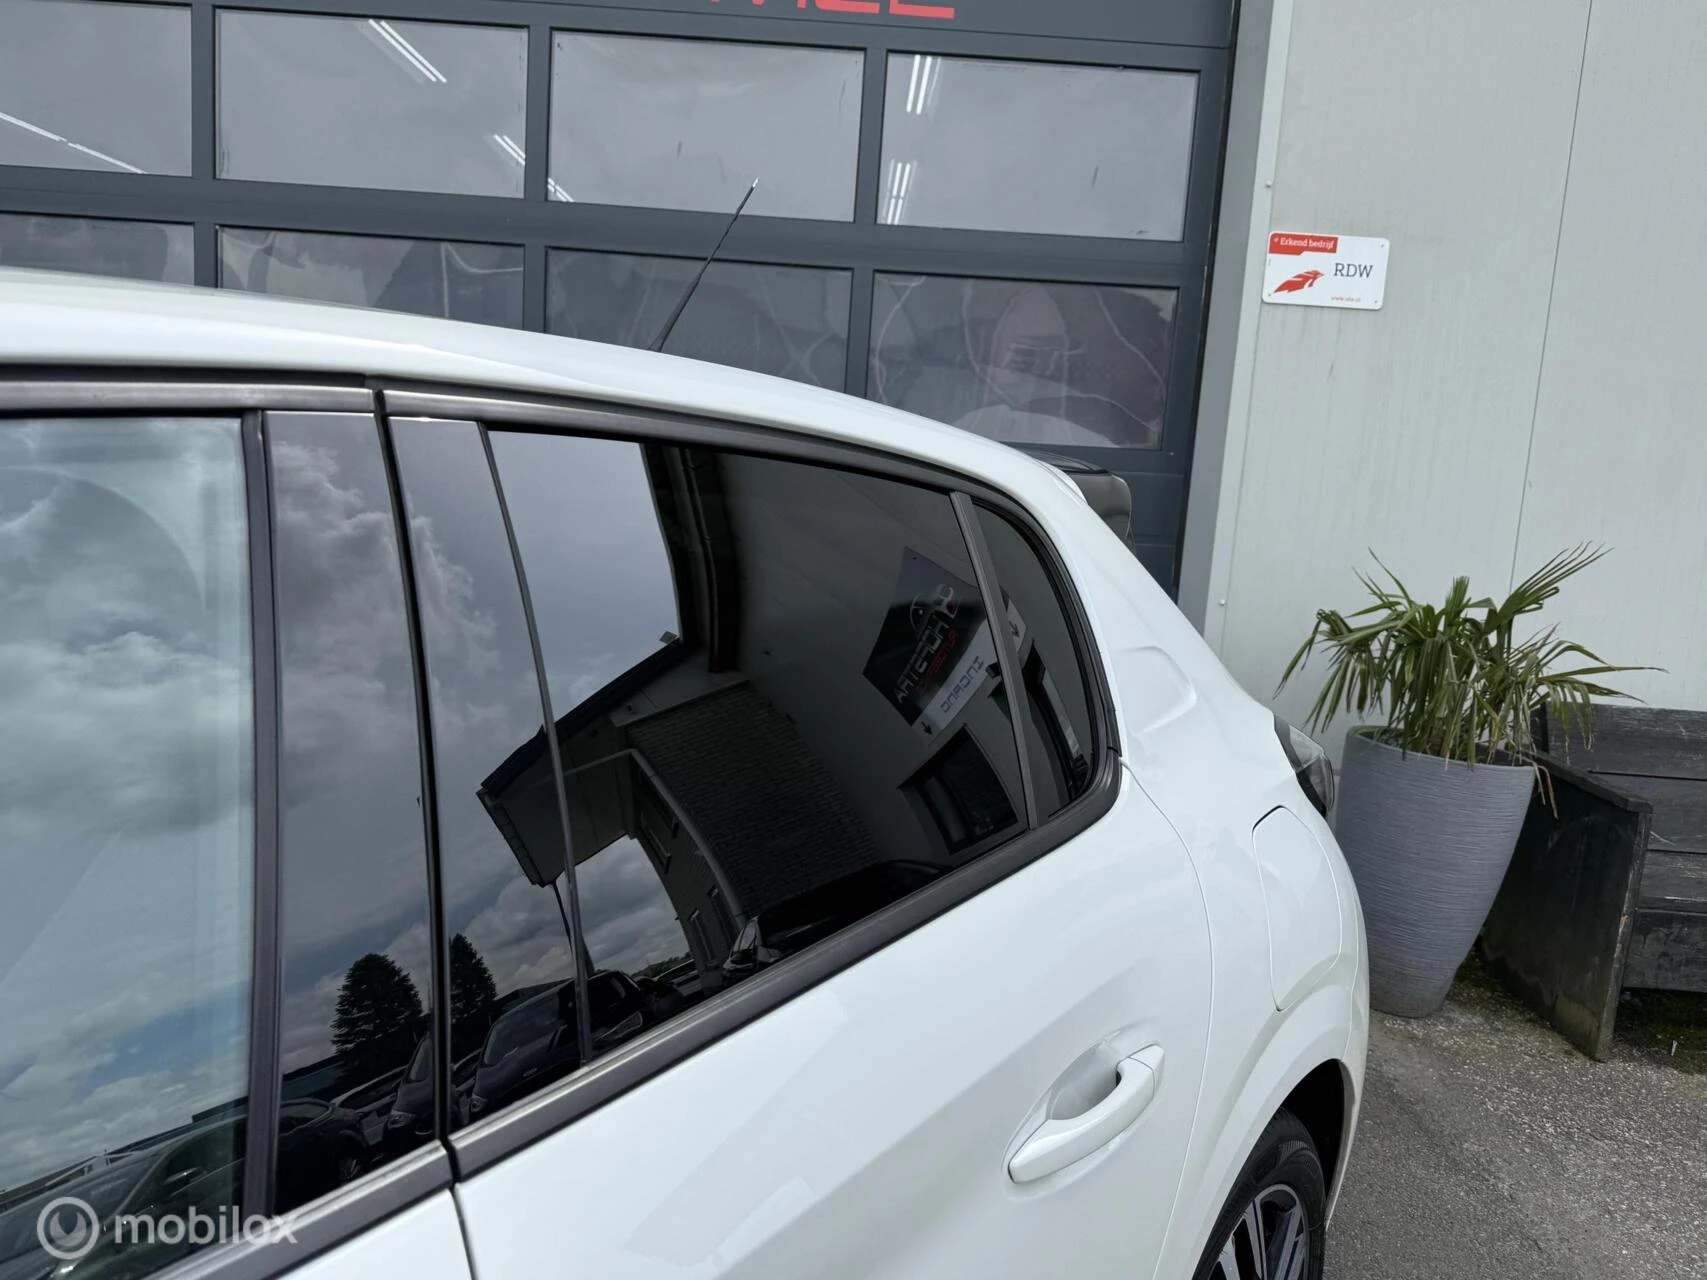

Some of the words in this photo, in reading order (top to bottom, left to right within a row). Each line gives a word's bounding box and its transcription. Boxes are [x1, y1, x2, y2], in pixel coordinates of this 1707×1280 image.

[1280, 237, 1308, 247] Erkend
[1309, 238, 1335, 250] bedrijf
[1333, 262, 1374, 279] RDW
